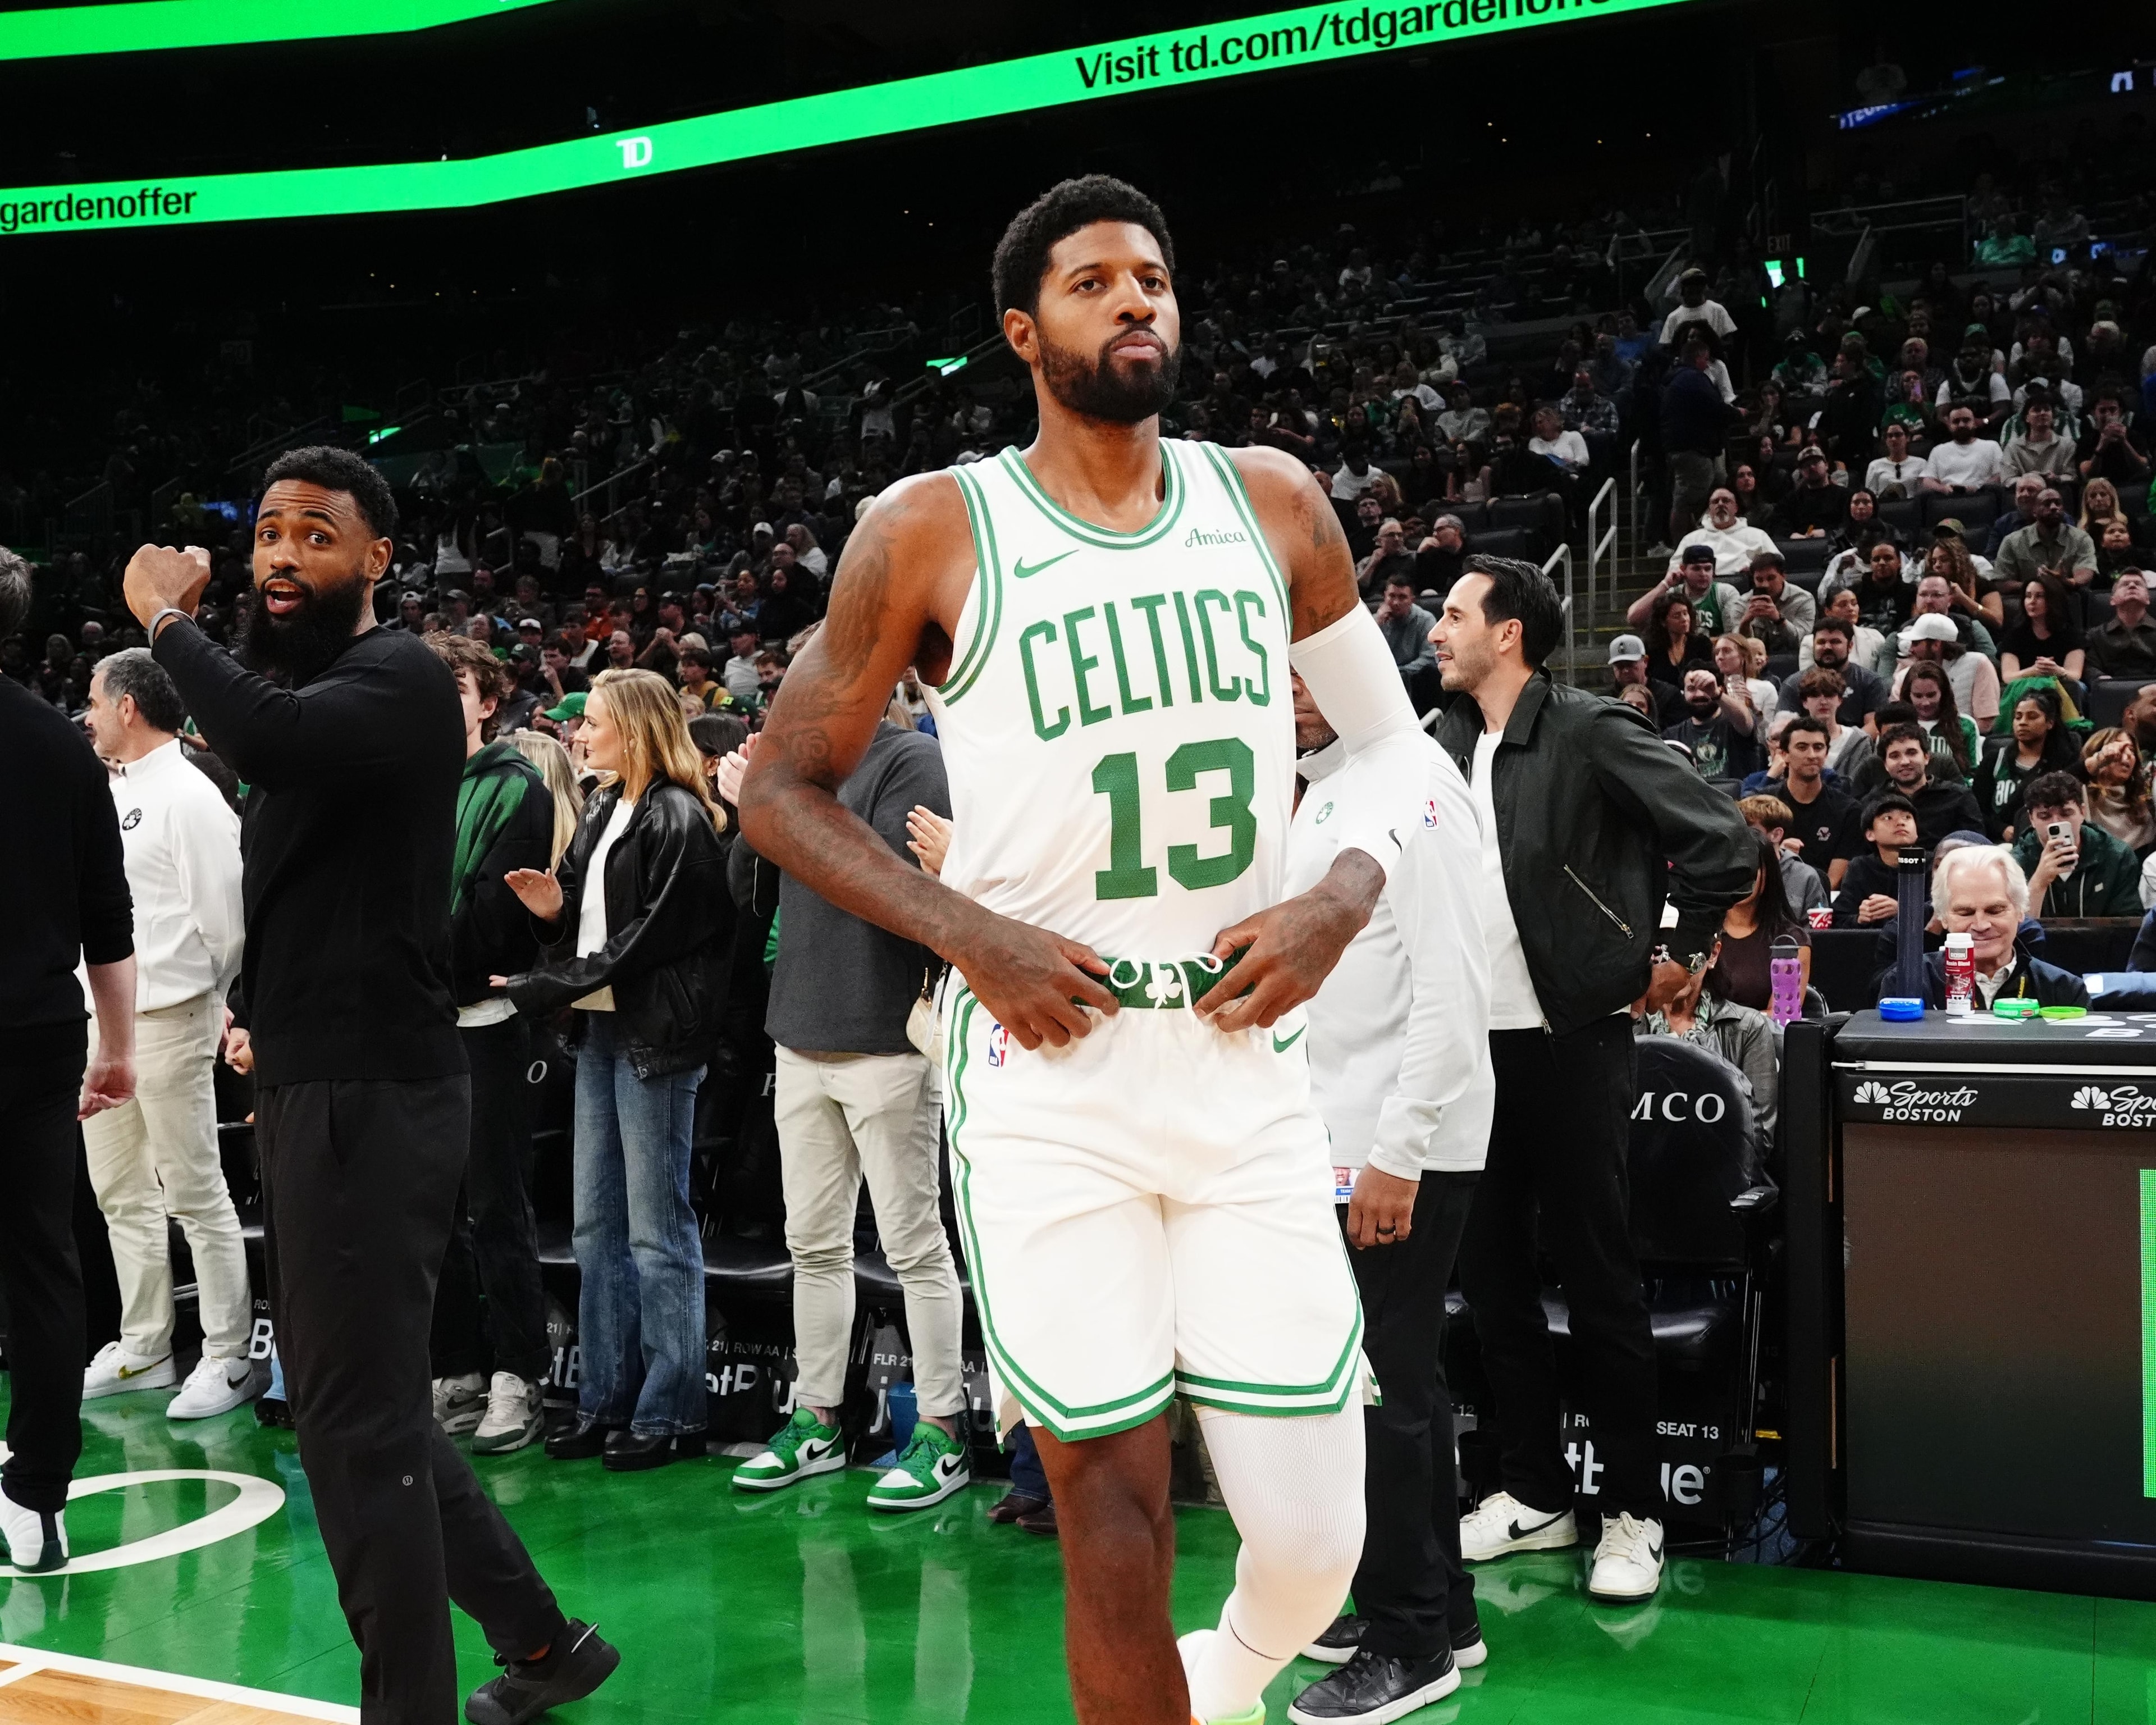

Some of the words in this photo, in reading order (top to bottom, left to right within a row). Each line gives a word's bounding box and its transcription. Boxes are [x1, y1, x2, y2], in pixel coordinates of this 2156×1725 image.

[1076, 45, 1159, 88] Visit
[615, 136, 652, 168] TD
[0, 187, 197, 232] gardenoffer
[1185, 528, 1246, 547] Amica
[1018, 588, 1271, 742] CELTICS
[1091, 737, 1257, 901] 13
[1630, 1092, 1725, 1123] MCO
[1890, 1081, 1979, 1112] Sports
[1883, 1107, 1961, 1122] BOSTON
[2102, 1113, 2156, 1128] BOST
[733, 1341, 762, 1355] ROW
[873, 1353, 897, 1366] FLR
[1656, 1421, 1697, 1437] SEAT
[1701, 1425, 1719, 1440] 13
